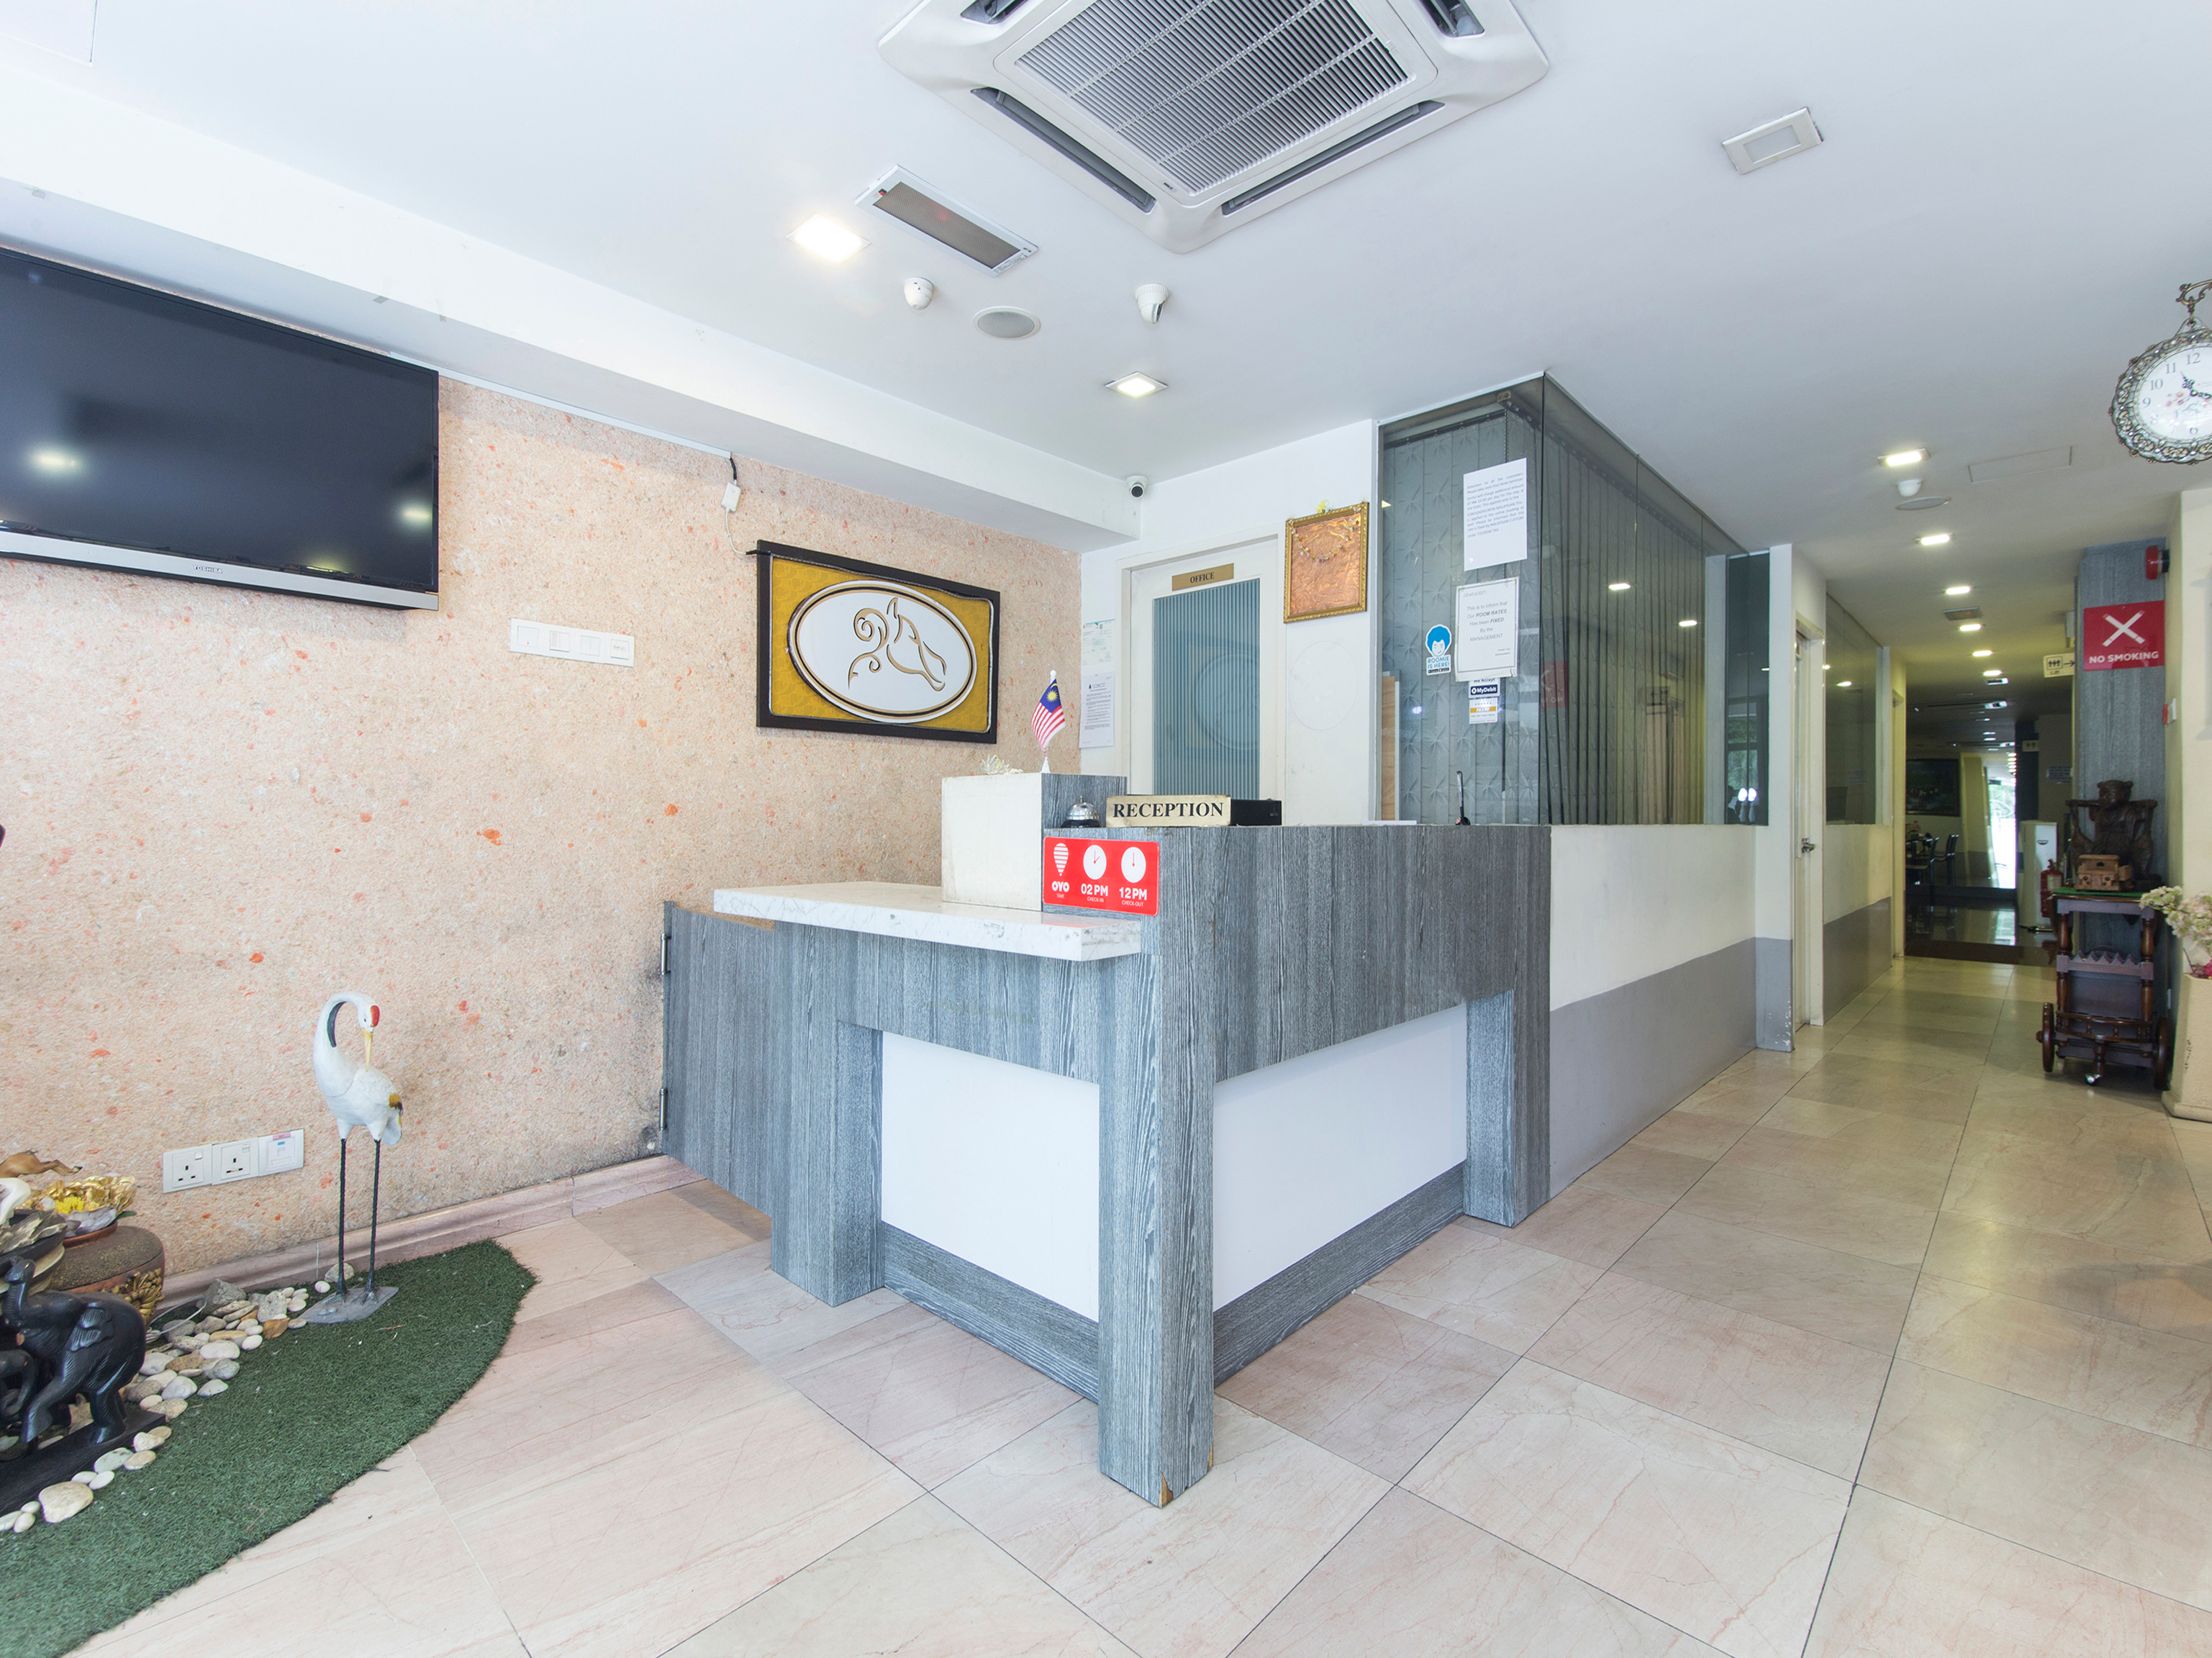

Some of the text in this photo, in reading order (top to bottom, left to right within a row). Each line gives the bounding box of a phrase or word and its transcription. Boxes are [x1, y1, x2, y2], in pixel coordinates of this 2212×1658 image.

[2186, 353, 2201, 365] 12
[2166, 362, 2176, 374] 11
[2150, 379, 2163, 391] 10
[2142, 397, 2151, 409] 9
[193, 565, 223, 574] TOSHIBA
[1189, 571, 1215, 584] OFFICE
[2089, 651, 2159, 664] NO SMOKING
[1112, 802, 1224, 817] RECEPTION
[1051, 880, 1070, 893] OYO
